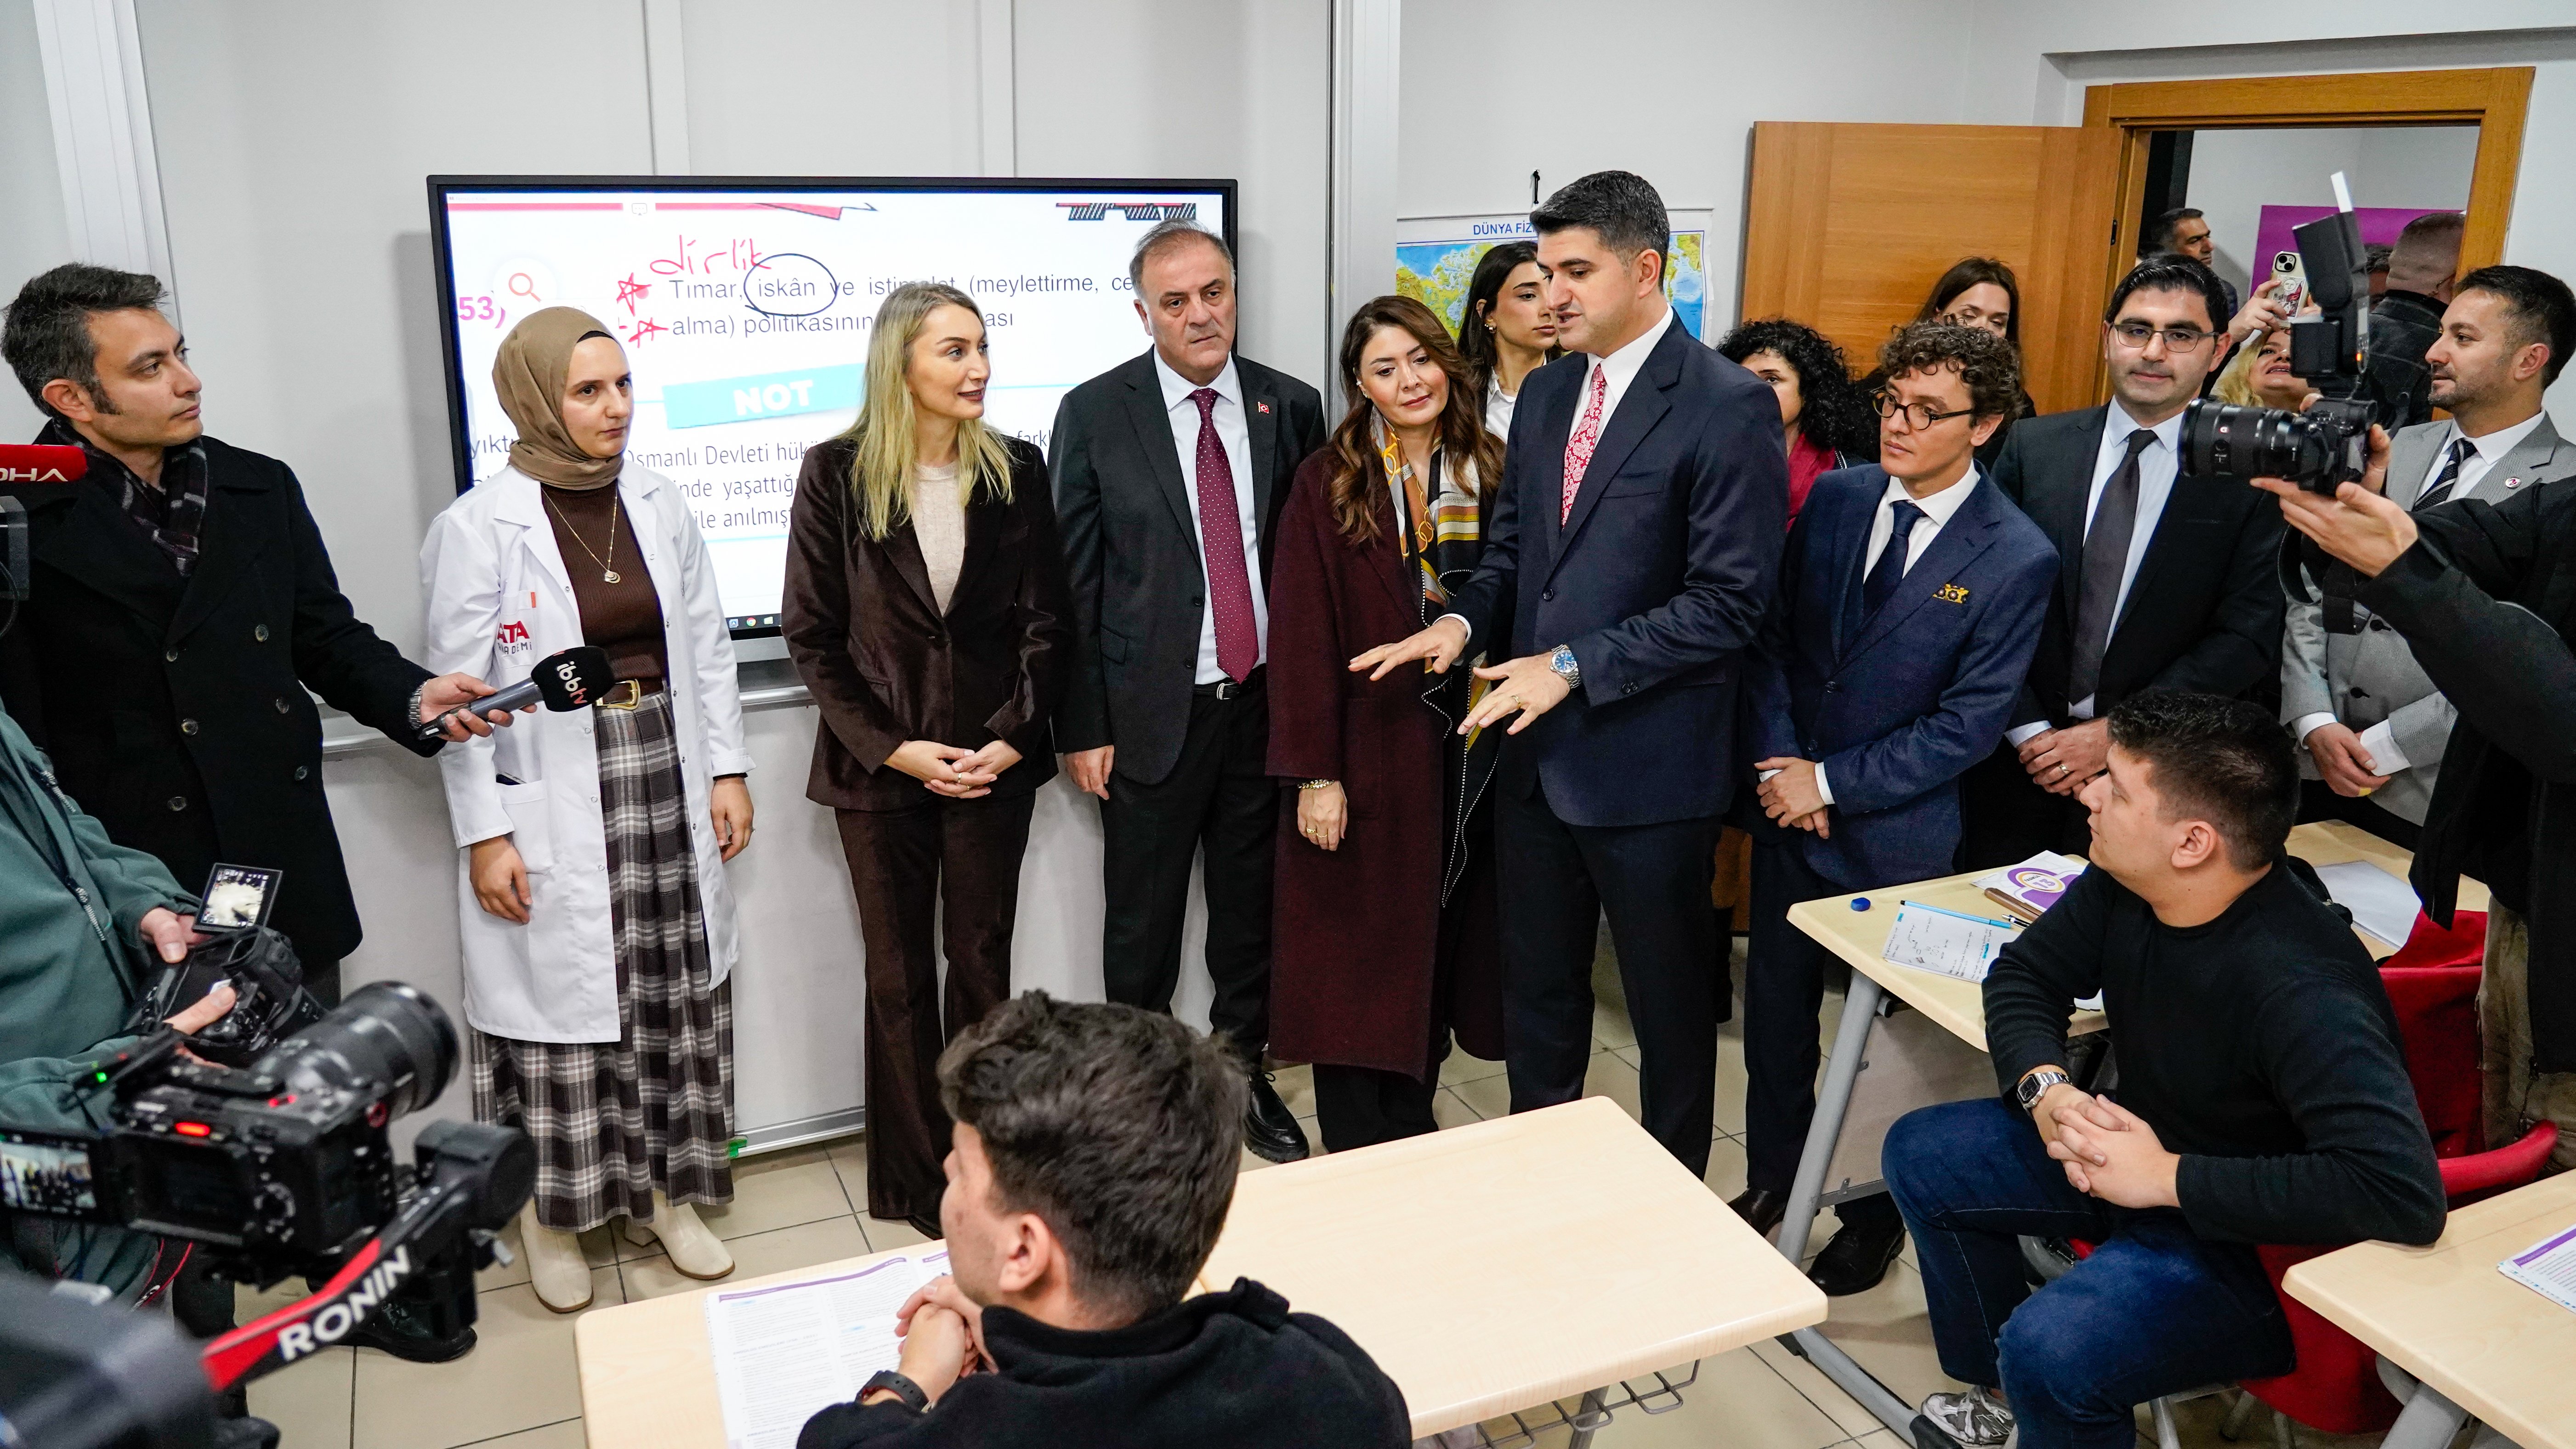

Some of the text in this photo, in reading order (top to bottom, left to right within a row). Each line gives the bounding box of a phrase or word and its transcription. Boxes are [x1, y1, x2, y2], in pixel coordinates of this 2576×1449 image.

[1473, 222, 1513, 235] DÜNYA
[650, 235, 772, 275] dirlik
[669, 280, 743, 300] Tımar,
[759, 278, 815, 297] iskân
[830, 280, 854, 295] ve
[970, 274, 1098, 298] (meylettirme,
[673, 315, 735, 339] alma)
[744, 314, 873, 338] politikasının
[733, 379, 813, 415] NOT
[471, 435, 513, 459] yıkt
[705, 443, 769, 465] Devleti
[723, 473, 798, 500] yaşattığ
[497, 621, 530, 643] ATA
[2032, 879, 2055, 889] 13
[277, 1245, 412, 1361] RONIN
